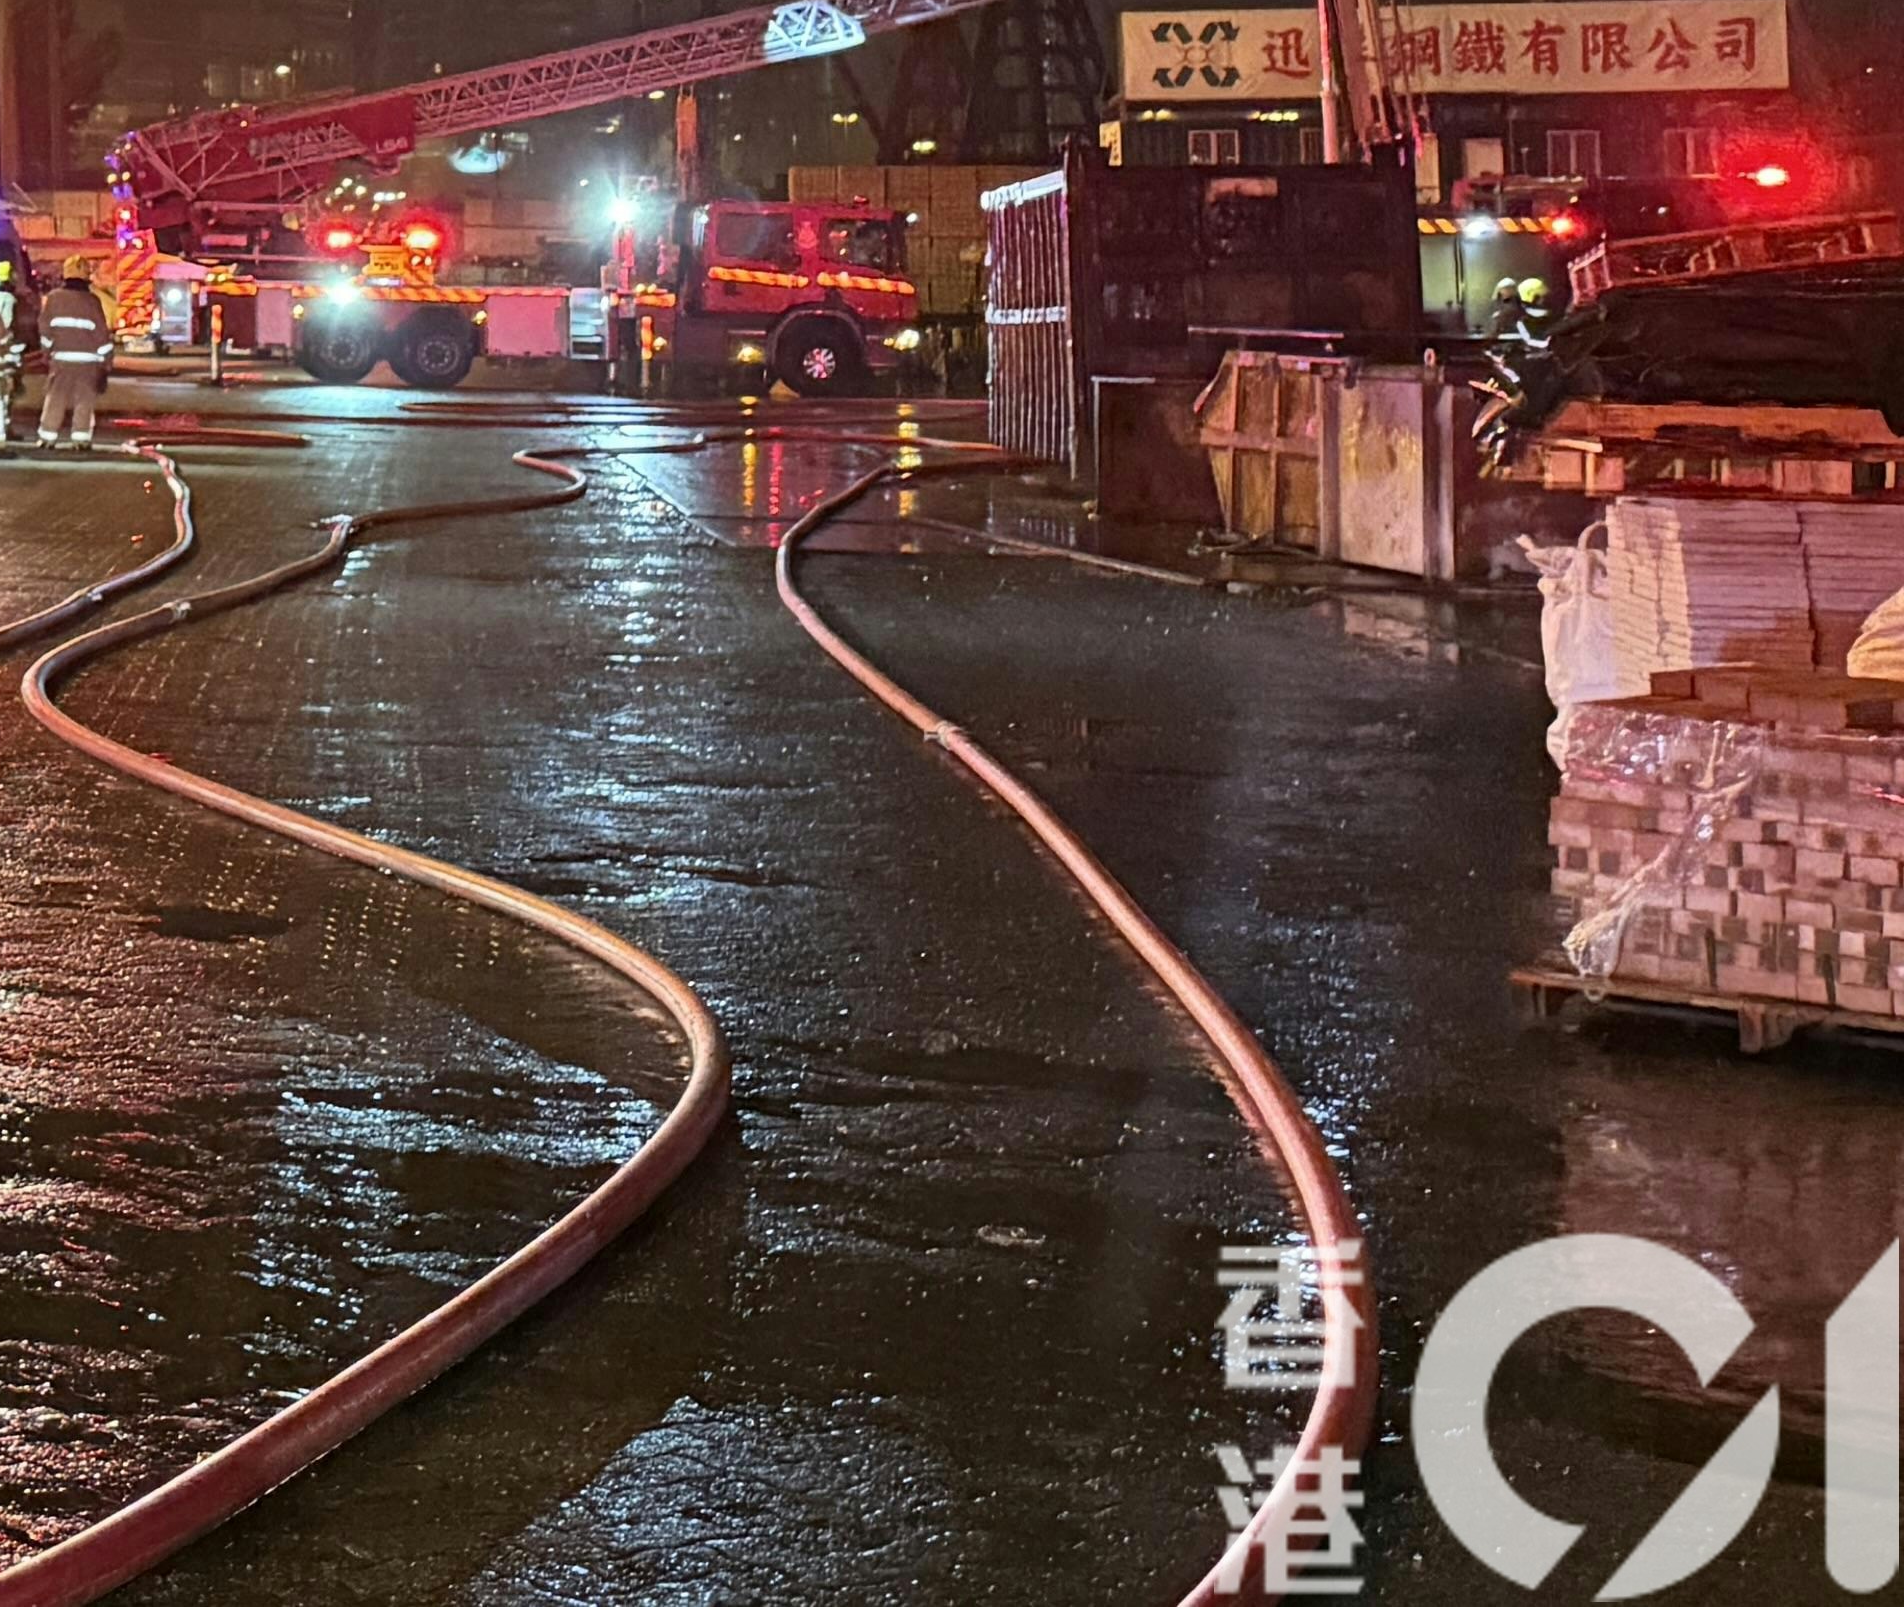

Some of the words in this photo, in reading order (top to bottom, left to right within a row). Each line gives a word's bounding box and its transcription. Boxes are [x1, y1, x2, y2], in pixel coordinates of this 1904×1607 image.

[1261, 16, 1759, 79] 迅鋼鐵有限公司
